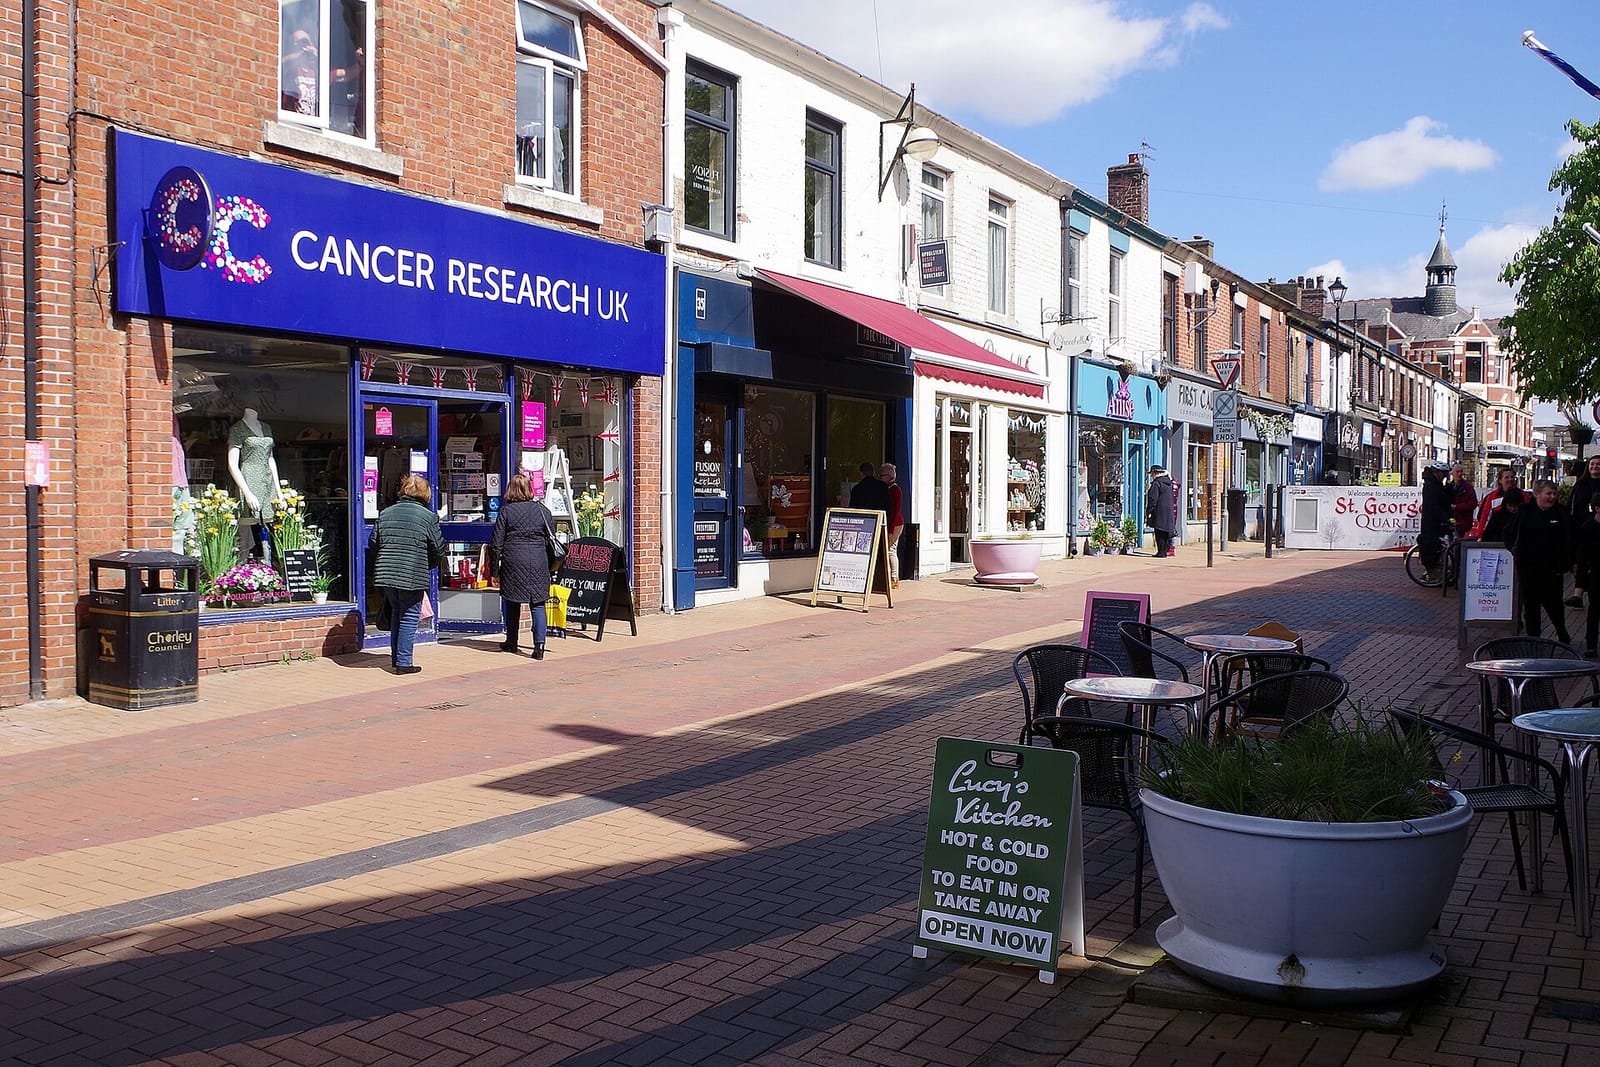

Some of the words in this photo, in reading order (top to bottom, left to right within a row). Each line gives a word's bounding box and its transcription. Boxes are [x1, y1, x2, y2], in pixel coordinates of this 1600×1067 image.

[291, 230, 435, 291] CANCER
[448, 259, 589, 316] RESEARCH
[597, 289, 629, 323] UK
[1178, 385, 1198, 408] FIRST
[1106, 396, 1135, 420] Anise
[695, 462, 720, 473] FUSION
[1335, 496, 1358, 514] St.
[1348, 489, 1373, 497] Welcome
[1383, 489, 1409, 499] shopping
[1355, 513, 1419, 531] QUARTE
[560, 578, 584, 589] APPLY
[584, 581, 607, 592] ONLINE
[157, 597, 180, 607] Litter
[147, 629, 192, 645] Chorley
[148, 642, 184, 653] Council
[948, 760, 1029, 802] Lucy's
[954, 797, 1053, 829] Kitchen
[940, 829, 978, 849] HOT
[981, 836, 994, 851] &
[999, 838, 1049, 860] COLD
[966, 854, 1018, 876] FOOD
[931, 869, 955, 887] TO
[959, 875, 995, 894] EAT
[998, 881, 1018, 898] IN
[1022, 885, 1050, 904] OR
[934, 891, 980, 913] TAKE
[985, 900, 1043, 924] AWAY
[925, 917, 985, 943] OPEN
[990, 930, 1047, 954] NOW
